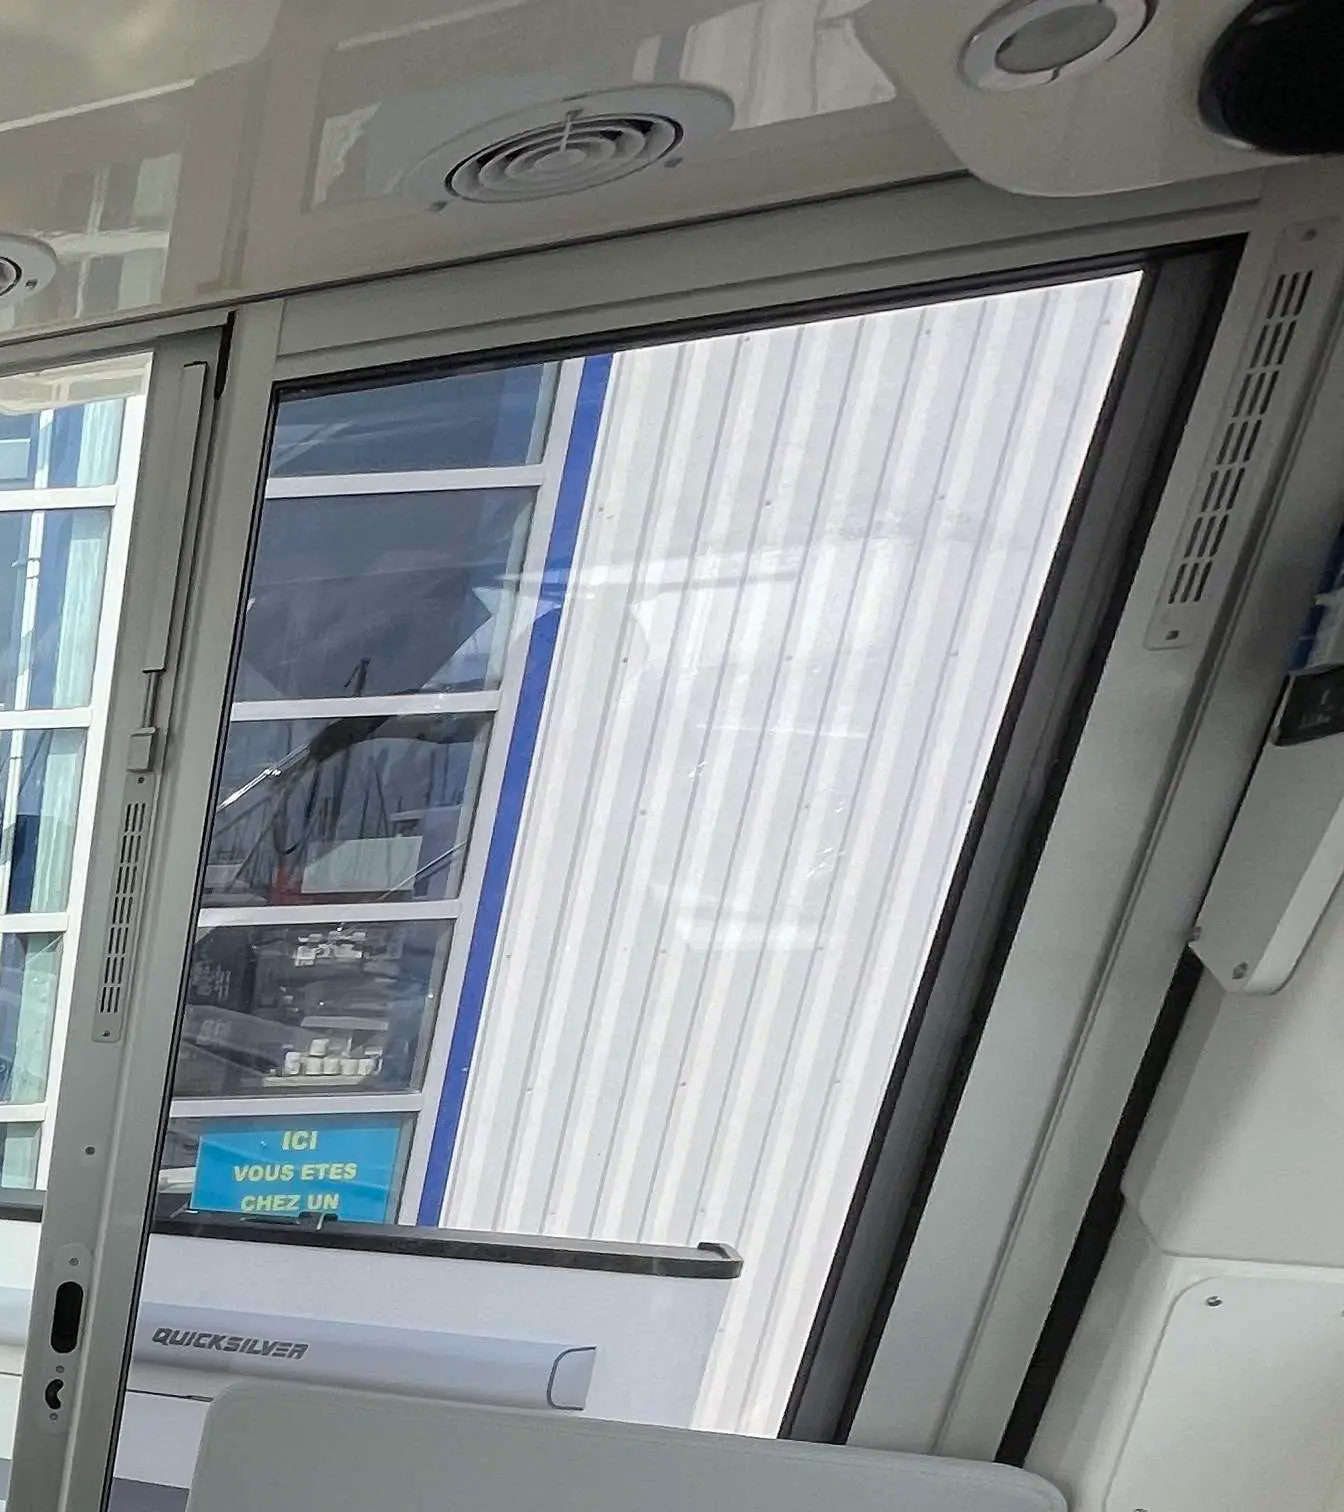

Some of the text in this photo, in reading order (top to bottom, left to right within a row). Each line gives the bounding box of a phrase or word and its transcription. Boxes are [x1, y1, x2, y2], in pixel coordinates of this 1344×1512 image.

[281, 1130, 319, 1151] ICI
[233, 1162, 358, 1182] VOUS ETES
[240, 1193, 340, 1211] CHEZ UN
[151, 1327, 309, 1360] QUICKSILVER
